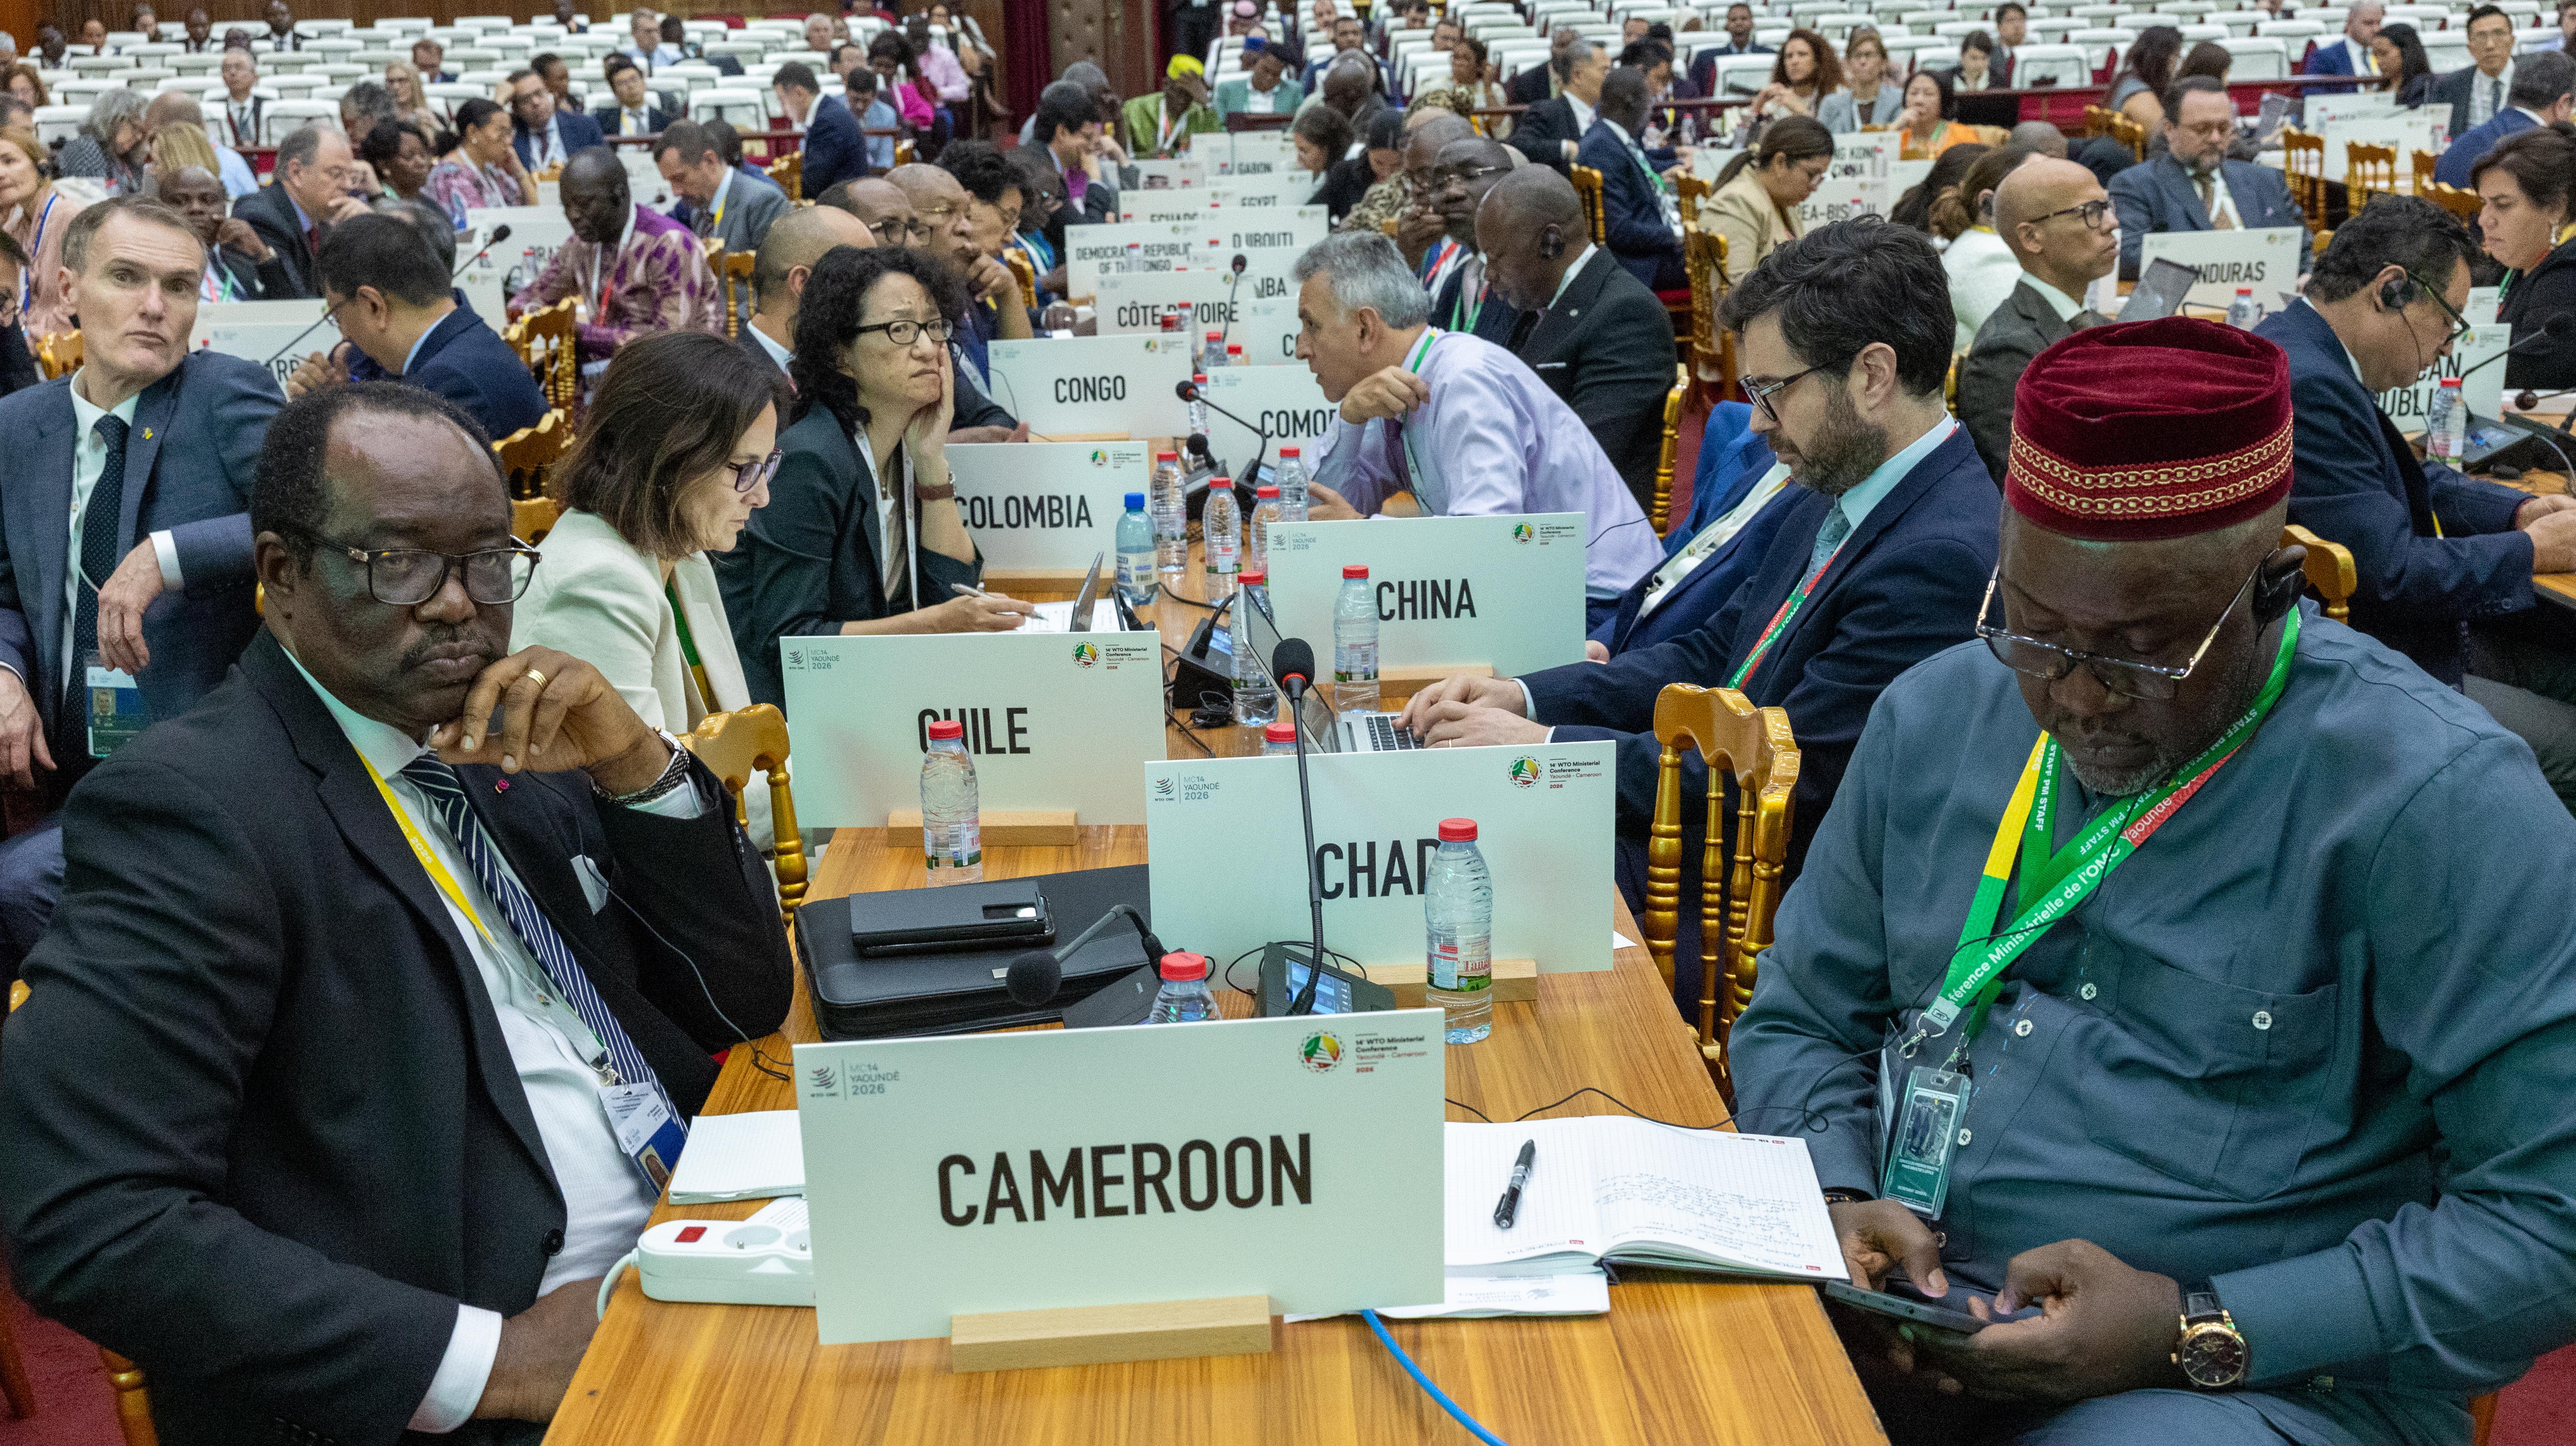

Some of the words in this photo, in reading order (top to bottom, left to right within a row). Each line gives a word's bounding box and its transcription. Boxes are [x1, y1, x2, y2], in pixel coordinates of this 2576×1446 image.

[1144, 258, 1171, 272] ONGO
[2196, 261, 2266, 284] NDURAS
[1118, 300, 1160, 328] CÔTE
[1055, 375, 1125, 404] CONGO
[1262, 409, 1337, 438] COMO
[1376, 578, 1477, 621] CHINA
[918, 707, 1030, 754] CHILE
[2045, 744, 2057, 776] STAFF
[1184, 782, 1220, 790] YAOUNDÉ
[1185, 791, 1209, 800] 2026
[2041, 779, 2050, 795] PM
[2035, 797, 2047, 831] STAFF
[2108, 812, 2126, 829] PM
[410, 836, 433, 863] 2026
[2080, 826, 2109, 855] STAFF
[1315, 838, 1441, 900] CHAD
[1988, 898, 2064, 963] Ministérielle
[2064, 882, 2081, 899] de
[1387, 1036, 1425, 1044] Ministerial
[850, 1071, 899, 1082] YAOUNDÉ
[851, 1084, 885, 1095] 2026
[938, 1133, 1311, 1227] CAMEROON
